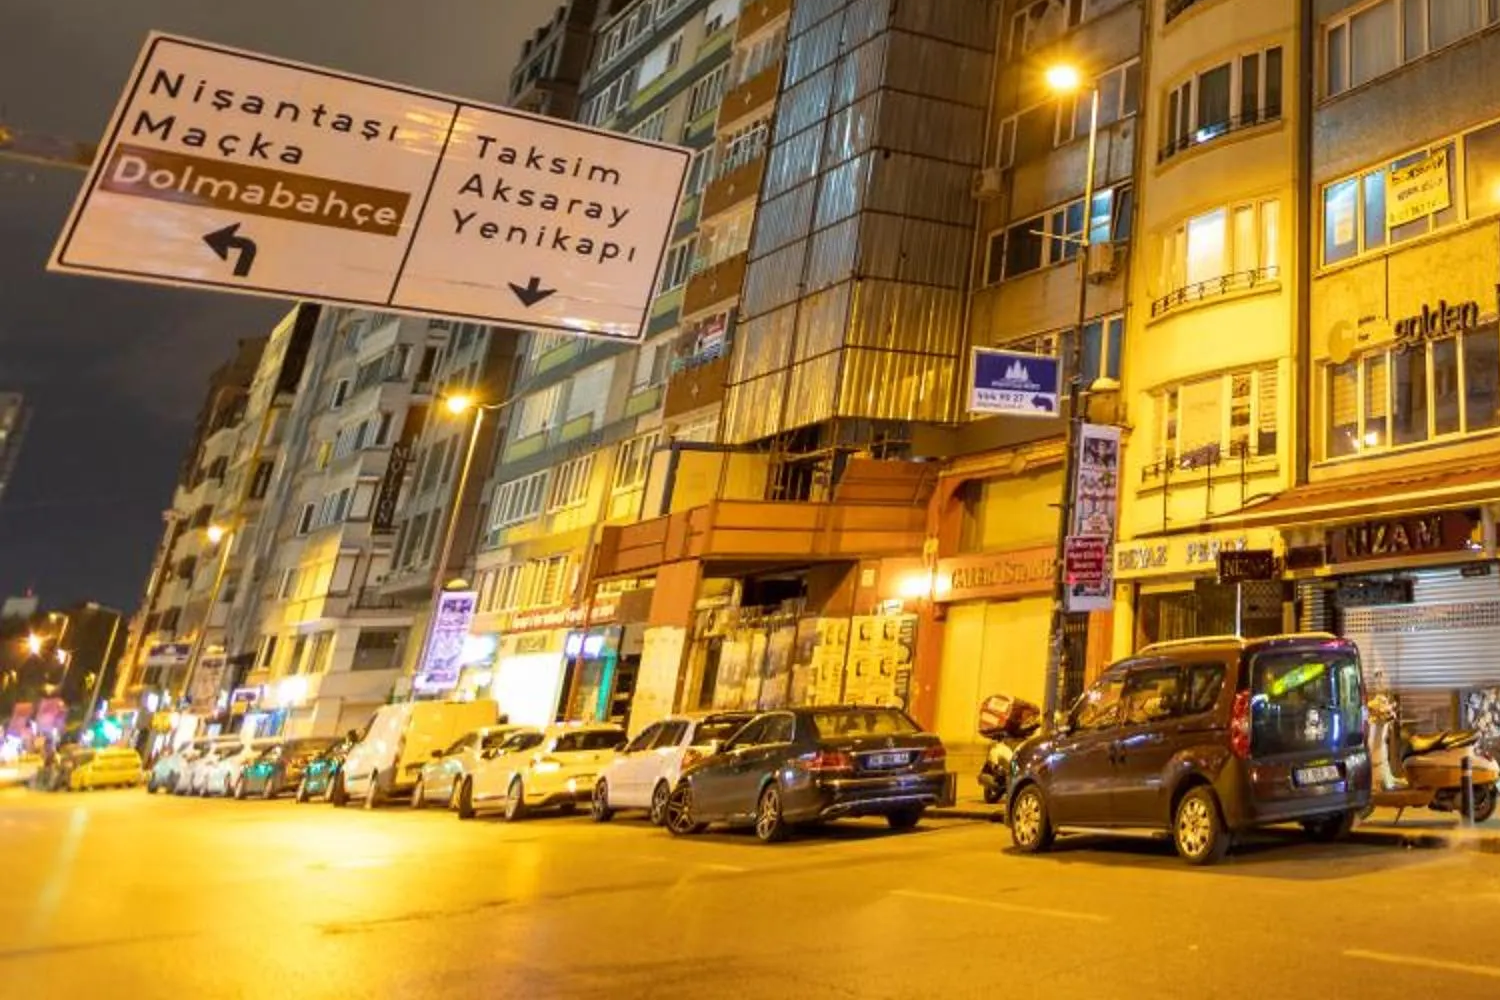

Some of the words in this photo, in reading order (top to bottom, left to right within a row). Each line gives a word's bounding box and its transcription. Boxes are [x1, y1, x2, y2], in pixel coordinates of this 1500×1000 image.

[148, 68, 401, 142] Nişantaşı
[132, 110, 304, 166] Maçka
[476, 136, 622, 186] Taksim
[112, 155, 398, 229] Dolmabahçe
[458, 174, 631, 228] Aksaray
[453, 210, 637, 264] Yenikapı
[1393, 298, 1481, 355] golden
